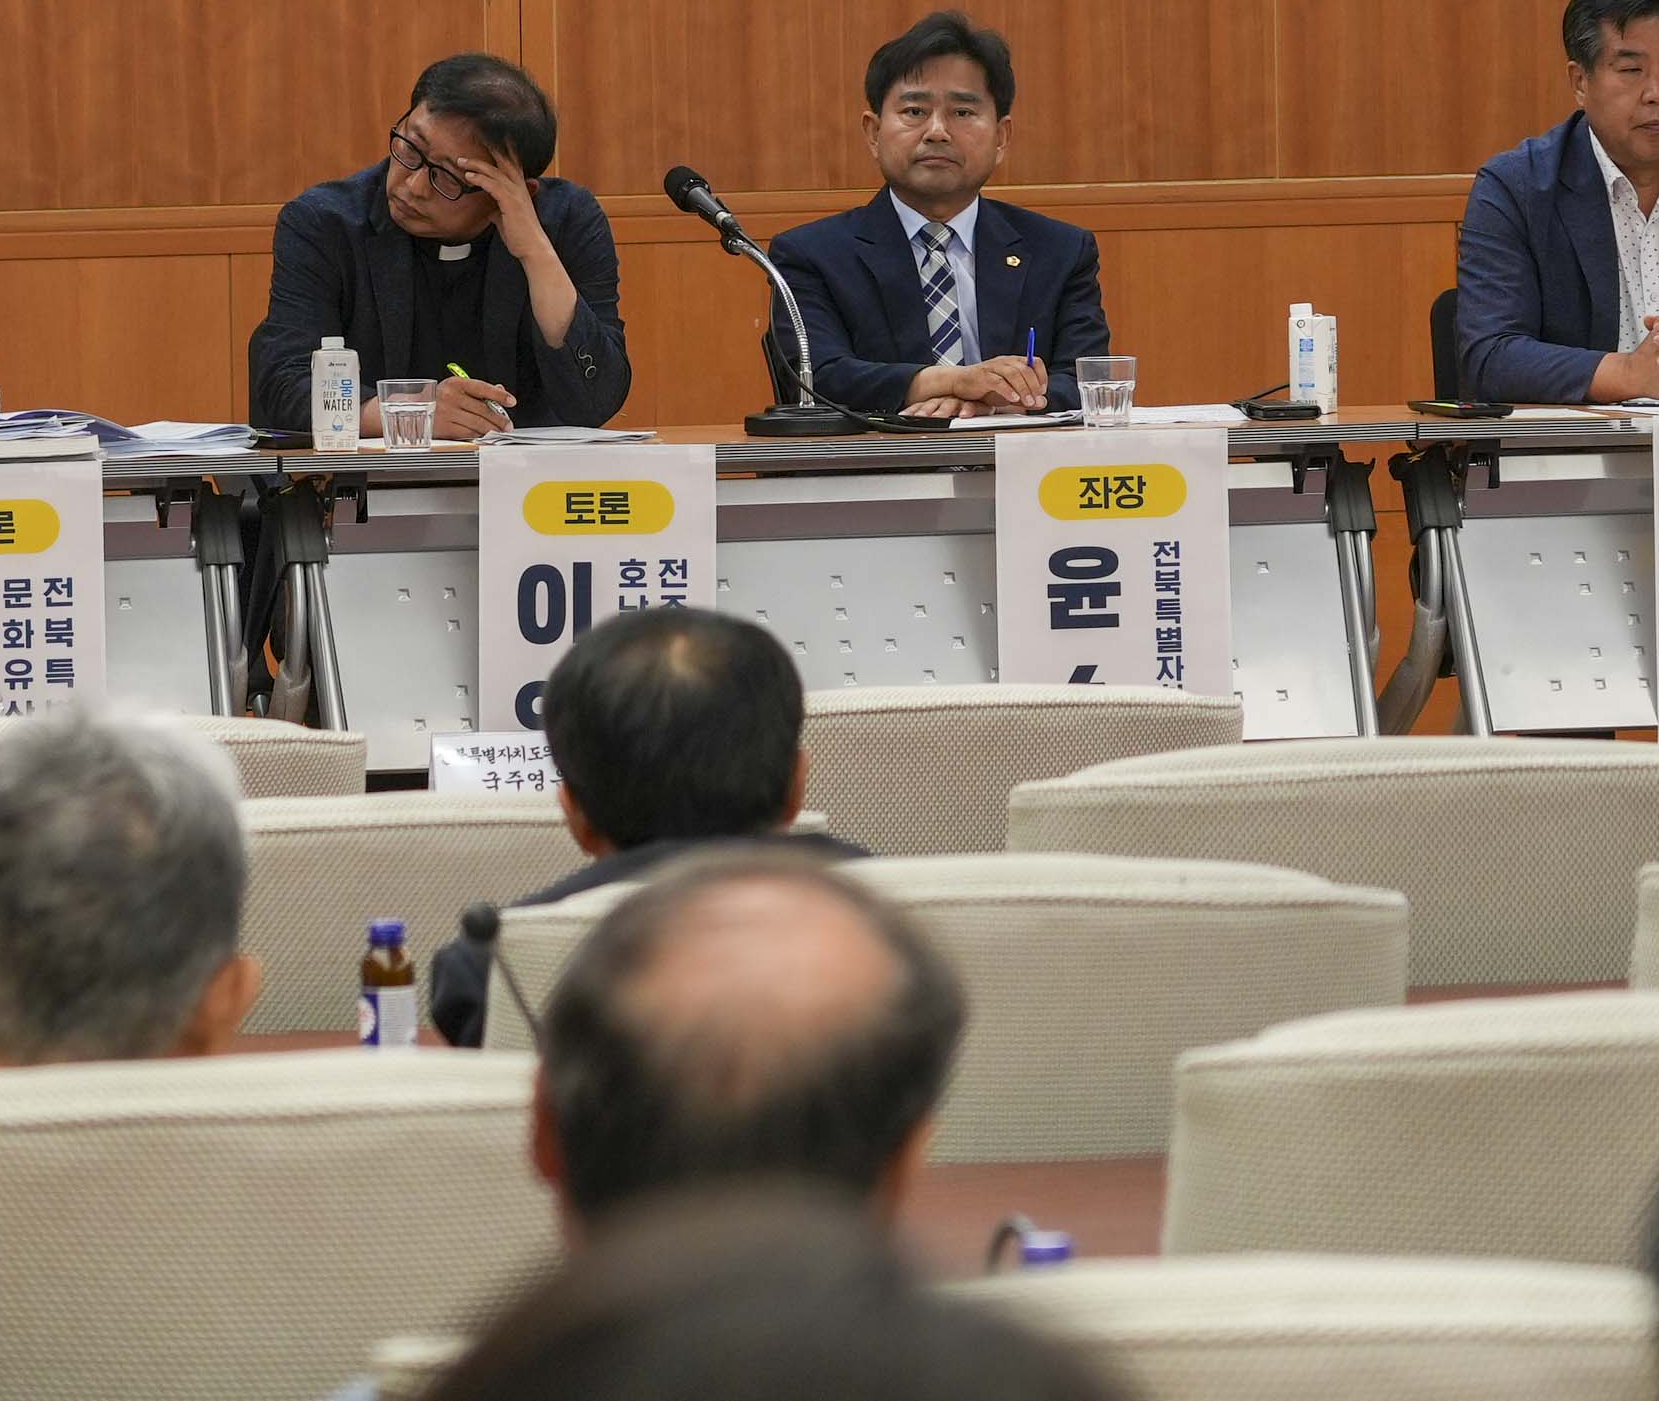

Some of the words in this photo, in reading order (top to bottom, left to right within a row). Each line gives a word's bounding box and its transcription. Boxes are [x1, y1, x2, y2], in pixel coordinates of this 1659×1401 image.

[323, 399, 353, 411] WATER
[564, 491, 631, 525] 토론
[1078, 475, 1147, 510] 좌장
[1153, 540, 1184, 691] 전북특별자
[43, 577, 75, 704] 전북특
